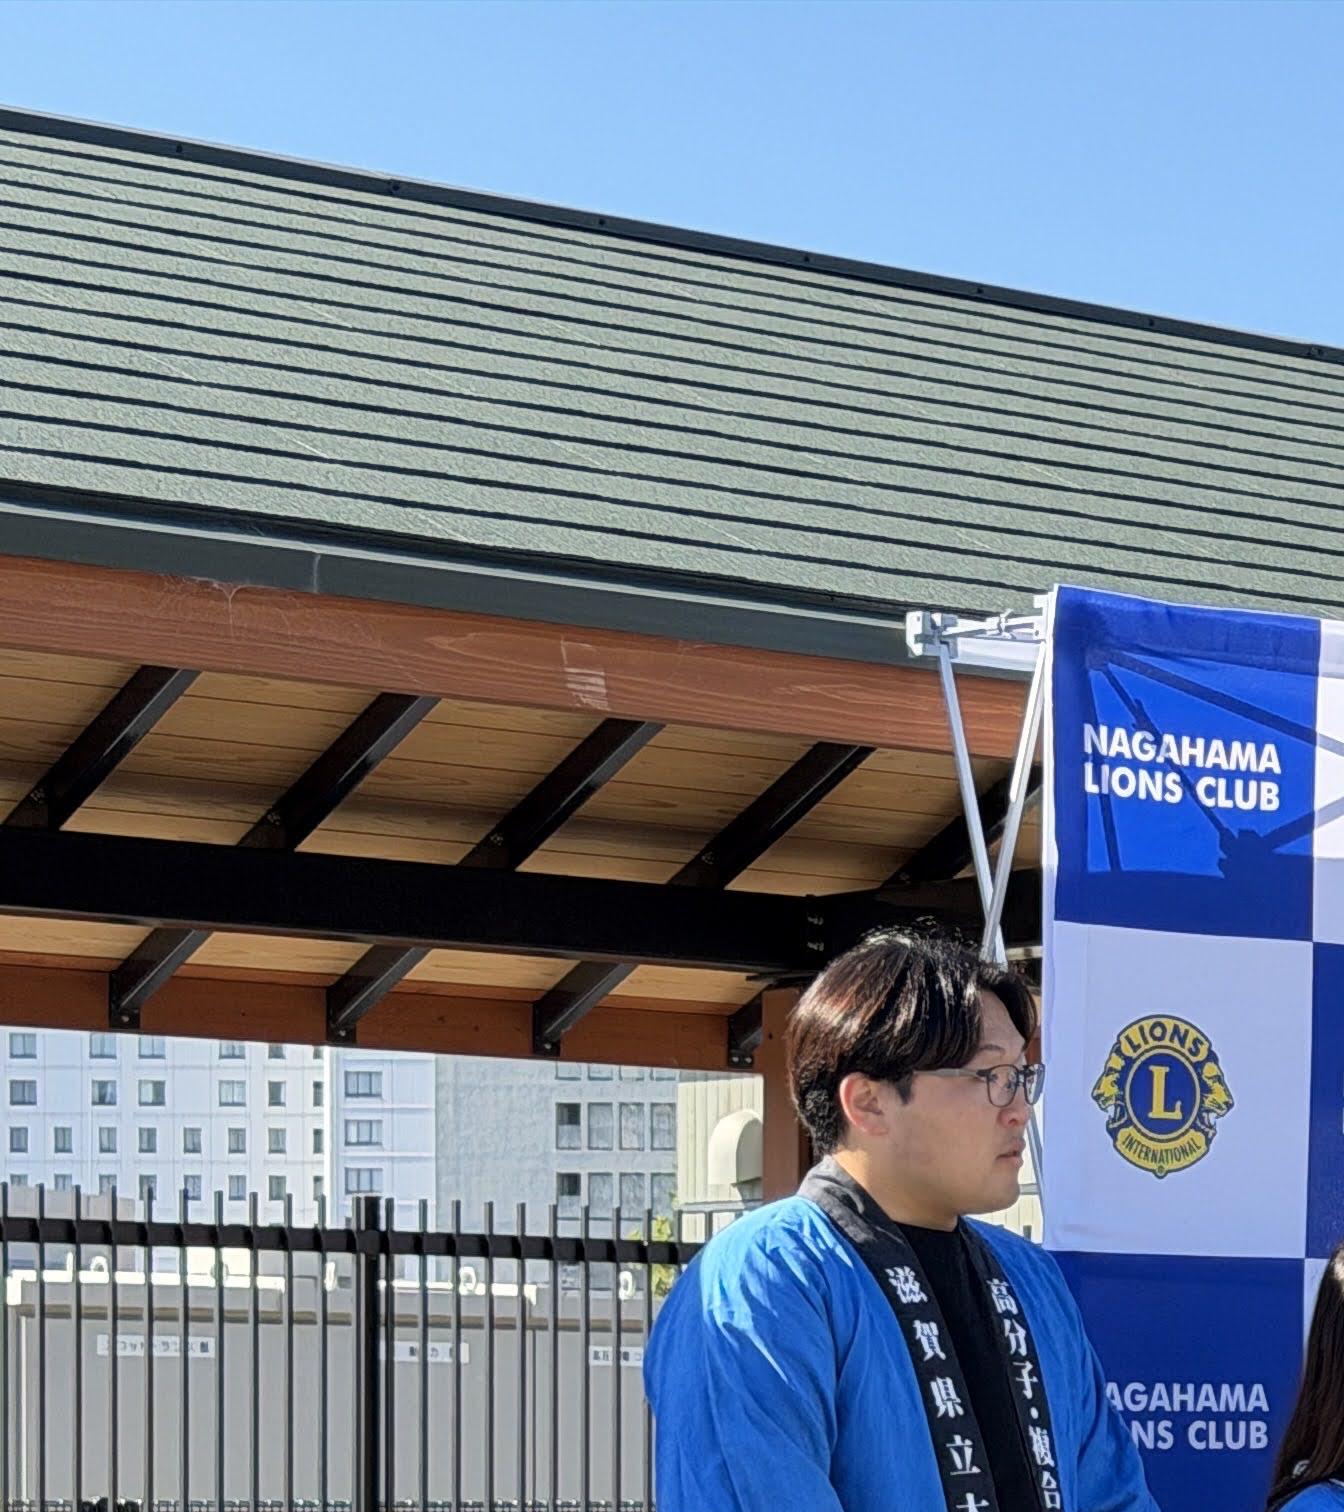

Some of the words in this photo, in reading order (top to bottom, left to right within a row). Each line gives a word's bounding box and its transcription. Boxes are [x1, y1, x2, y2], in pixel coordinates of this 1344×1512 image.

[1084, 724, 1281, 774] NAGAHAMA
[1083, 761, 1182, 803] LIONS
[1196, 776, 1280, 811] CLUB
[1124, 1021, 1204, 1057] LIONS
[1148, 1065, 1182, 1120] L
[1122, 1133, 1202, 1165] INTERNATIONAL
[1105, 1381, 1269, 1412] AGAHAMA
[1187, 1419, 1269, 1450] CLUB
